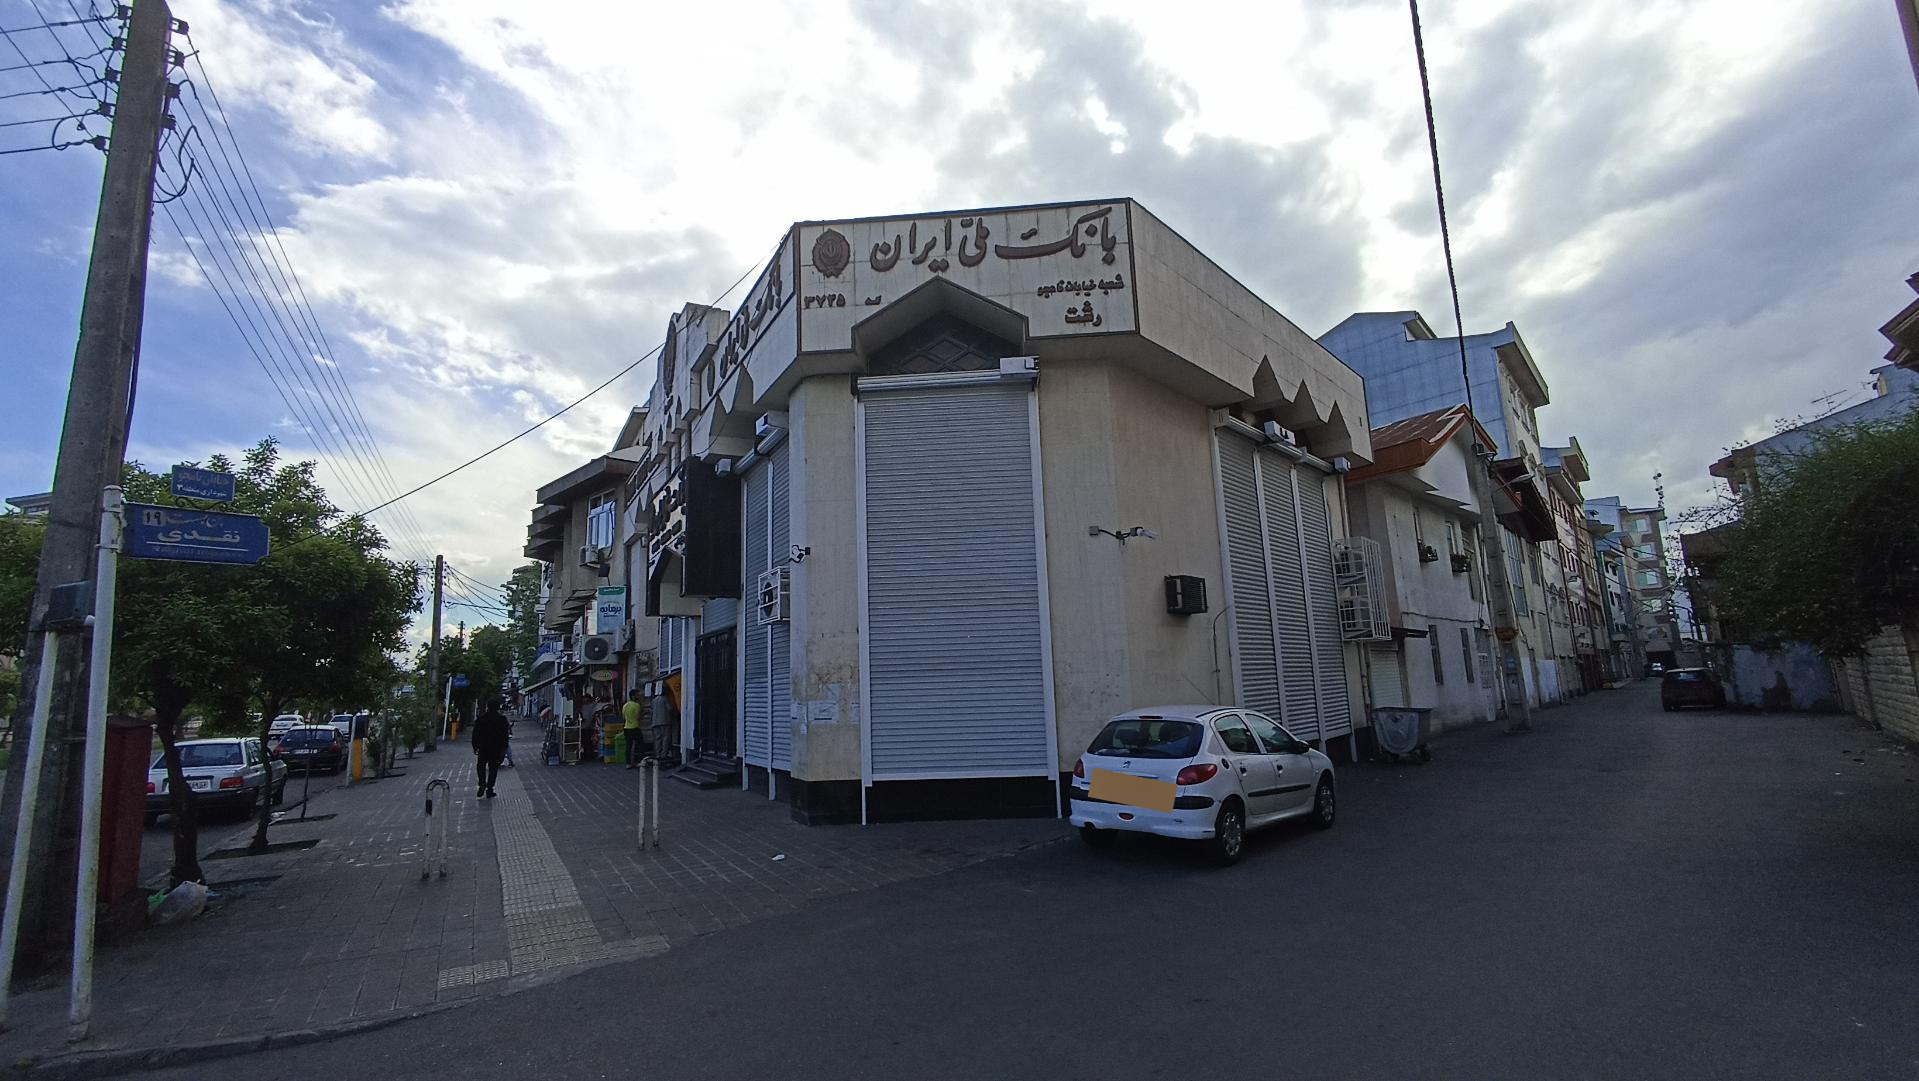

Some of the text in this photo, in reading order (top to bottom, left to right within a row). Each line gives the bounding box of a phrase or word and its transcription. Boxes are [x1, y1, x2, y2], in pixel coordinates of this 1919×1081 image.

[870, 218, 952, 272] ایران
[995, 206, 1117, 265] بانک
[1037, 273, 1125, 299] شعبه خیابان نامجو
[1064, 300, 1103, 327] رشت
[145, 511, 161, 526] ۱۹
[157, 530, 240, 543] نقدی
